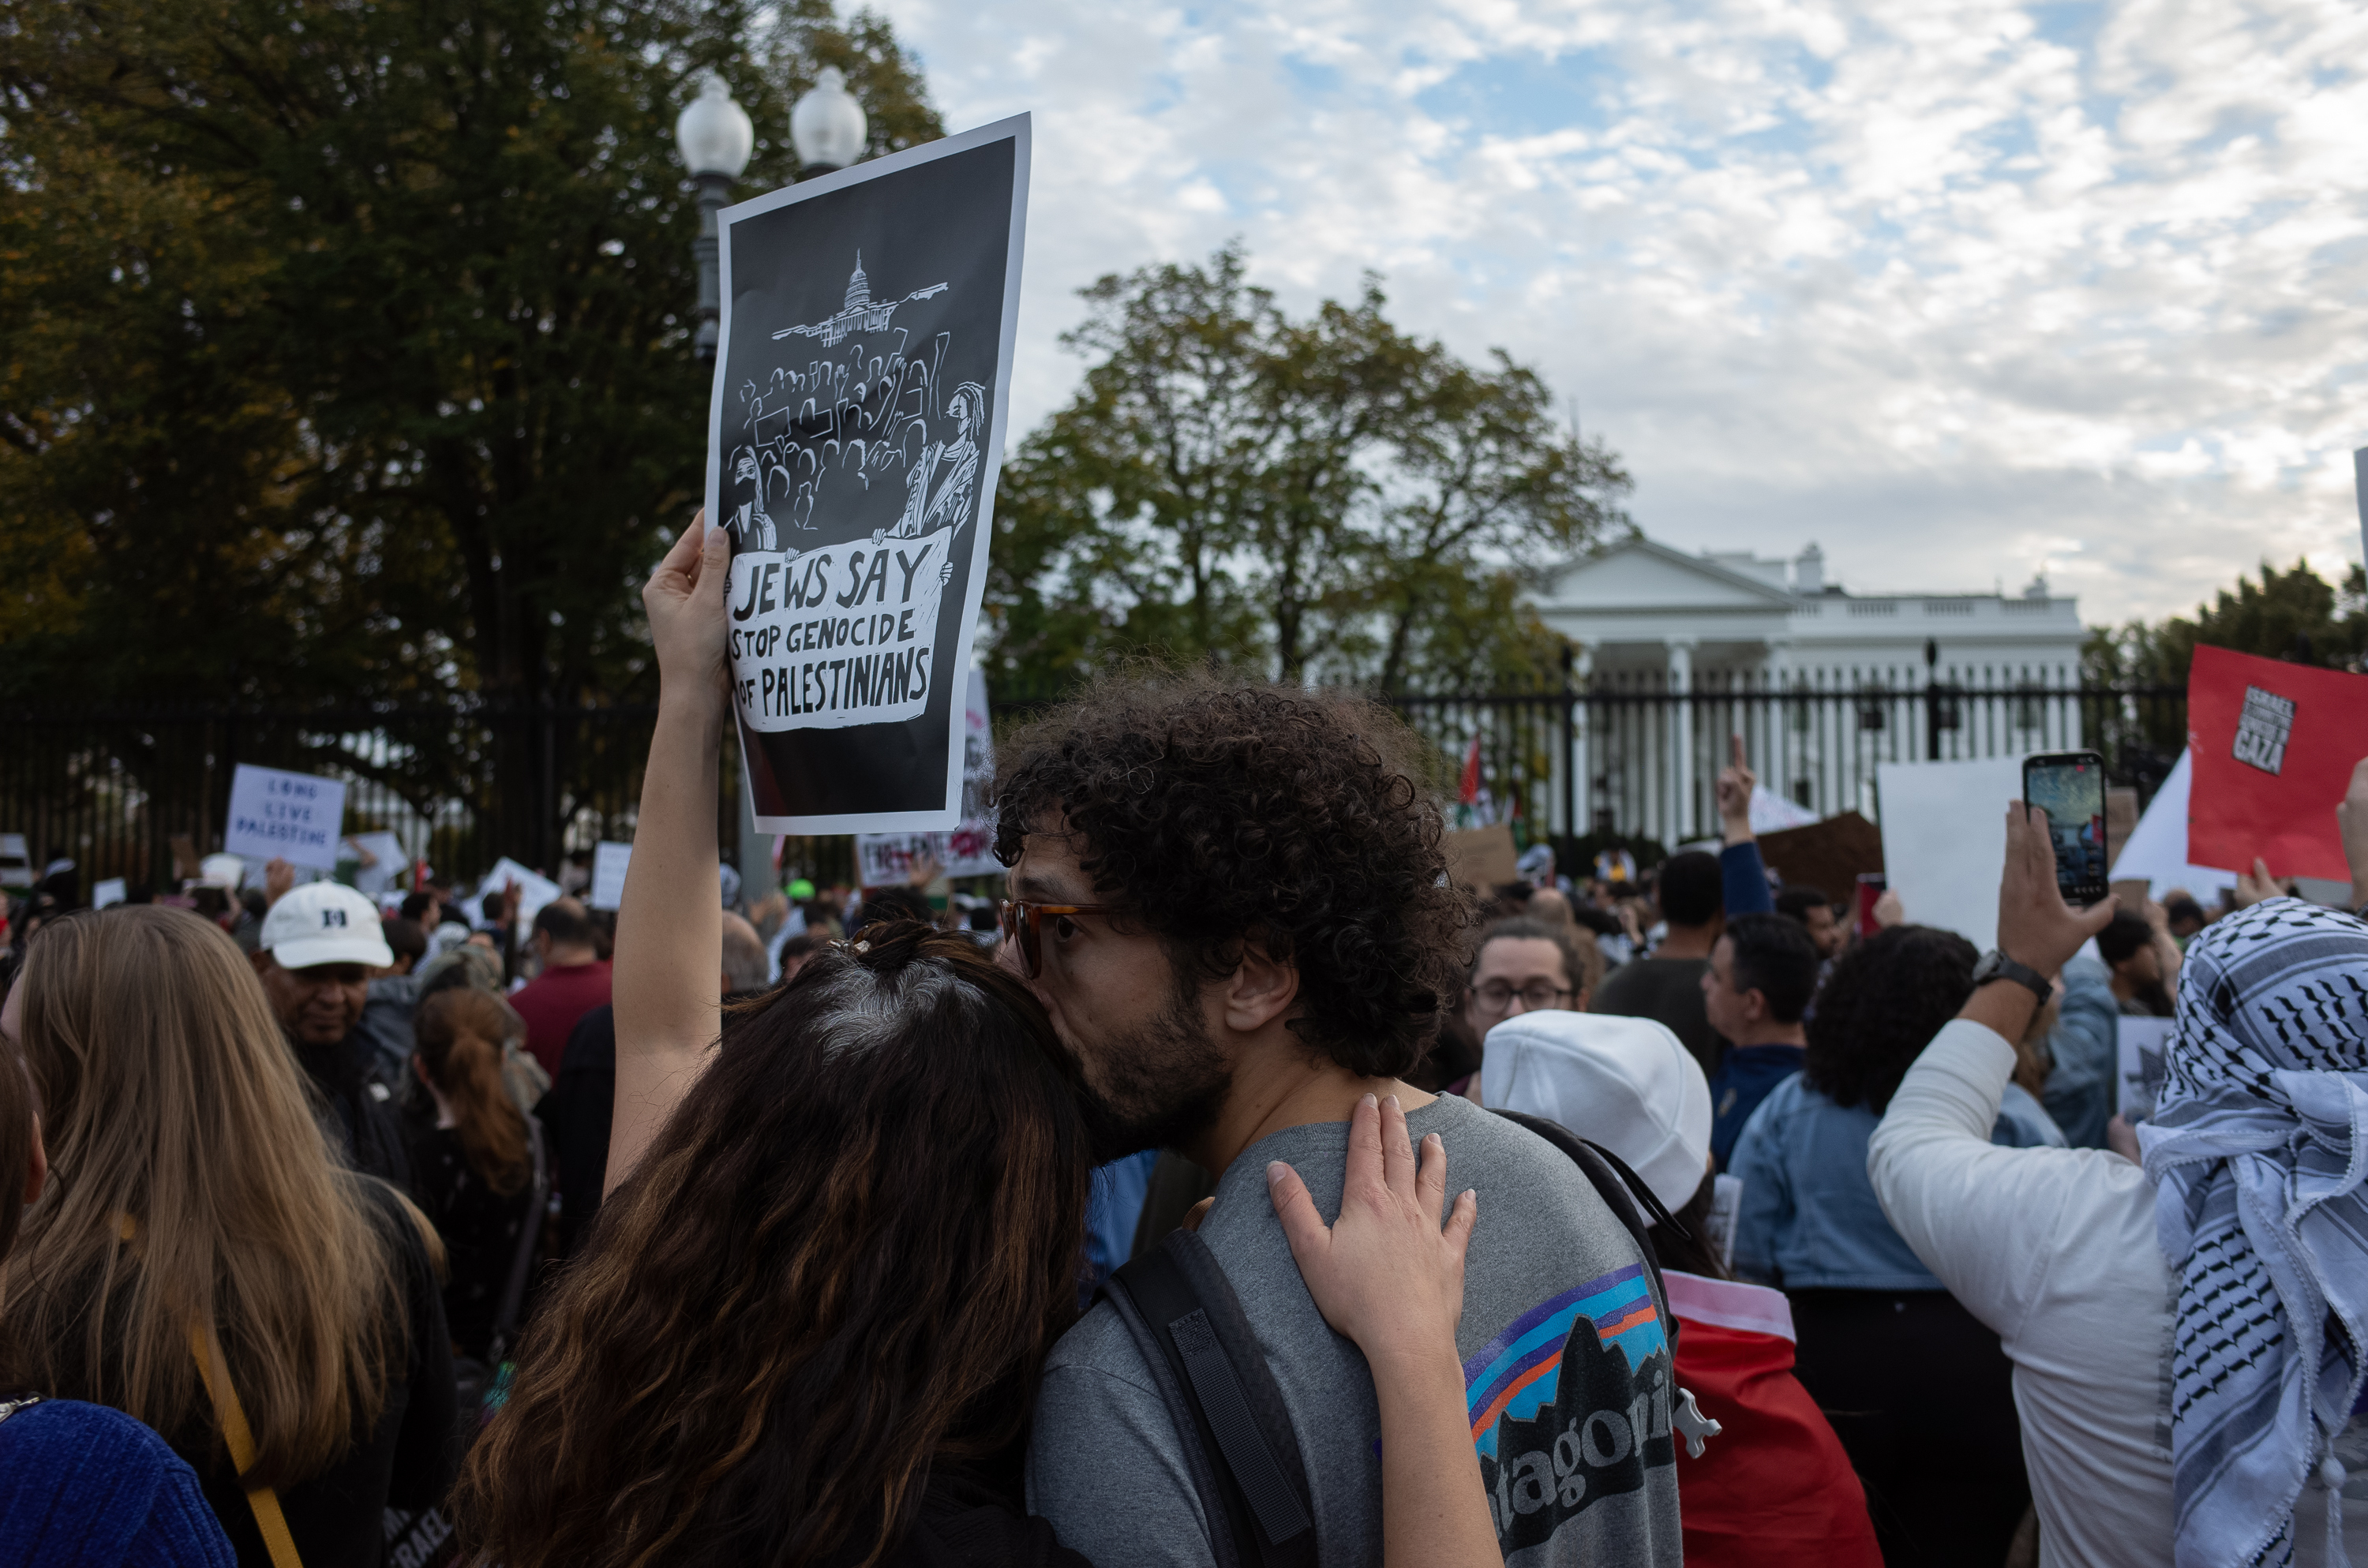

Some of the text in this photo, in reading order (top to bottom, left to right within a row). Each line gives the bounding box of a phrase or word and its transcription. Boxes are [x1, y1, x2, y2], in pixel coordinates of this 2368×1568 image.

[733, 543, 934, 622] JEWS SAY
[731, 608, 916, 661] STOP GENOCIDE
[739, 646, 930, 717] OF PALESTINIANS
[2233, 726, 2284, 776] GAZA
[266, 803, 311, 821] LIVE
[268, 779, 317, 799] LONG
[237, 817, 325, 845] PALESTINE
